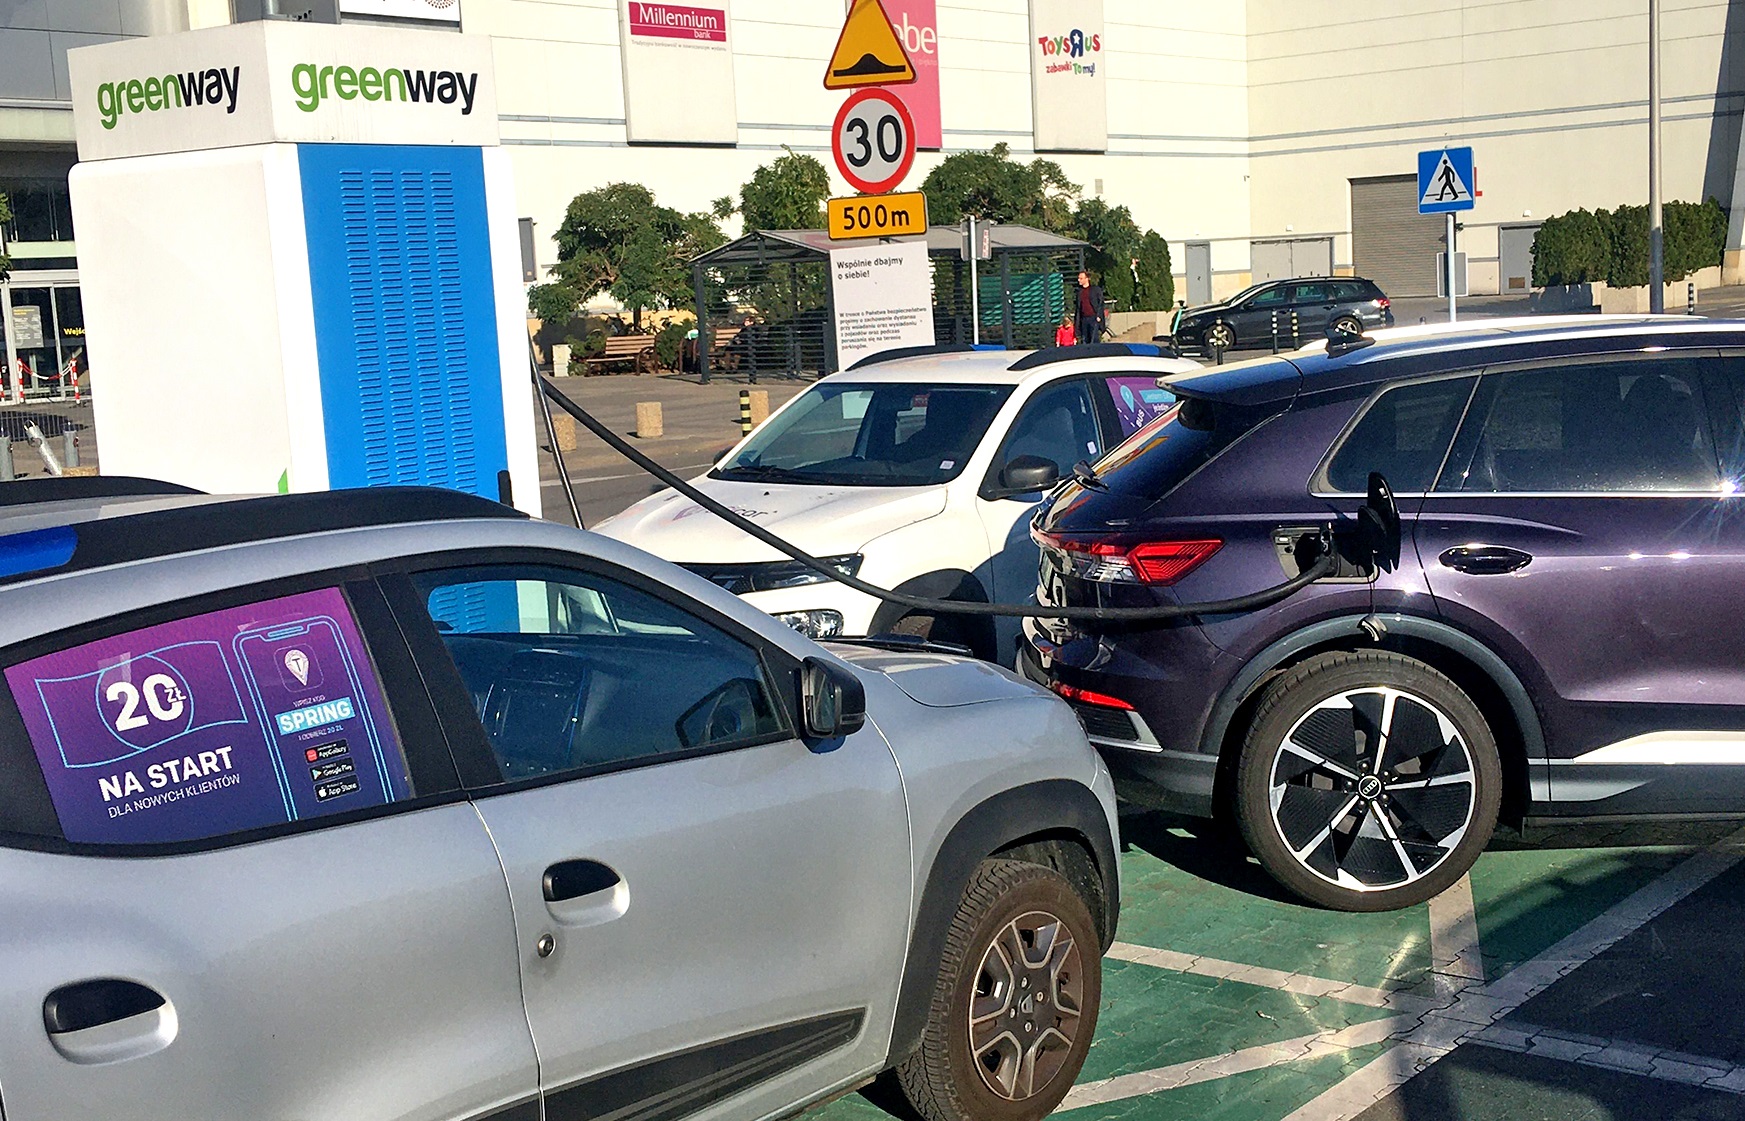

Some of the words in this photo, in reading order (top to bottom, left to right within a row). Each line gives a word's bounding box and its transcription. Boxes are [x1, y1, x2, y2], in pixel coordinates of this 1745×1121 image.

[639, 2, 717, 29] Millennium
[694, 29, 711, 39] bank
[1045, 61, 1072, 73] zabawki
[97, 66, 240, 130] greenway
[292, 63, 478, 115] greenway
[846, 114, 903, 167] 30
[836, 260, 872, 269] Wspólnie
[874, 257, 903, 266] dbajmy
[844, 270, 870, 279] siebie!
[880, 328, 900, 336] podczas
[106, 673, 184, 732] 20
[279, 700, 351, 732] SPRING
[326, 726, 336, 736] 20
[98, 771, 145, 802] NA
[147, 745, 233, 789] START
[322, 766, 342, 777] Google
[108, 802, 133, 819] DLA
[133, 788, 185, 811] NOWYCH
[186, 773, 241, 797] KLIENTÓW
[328, 786, 341, 797] App
[341, 782, 357, 792] Store
